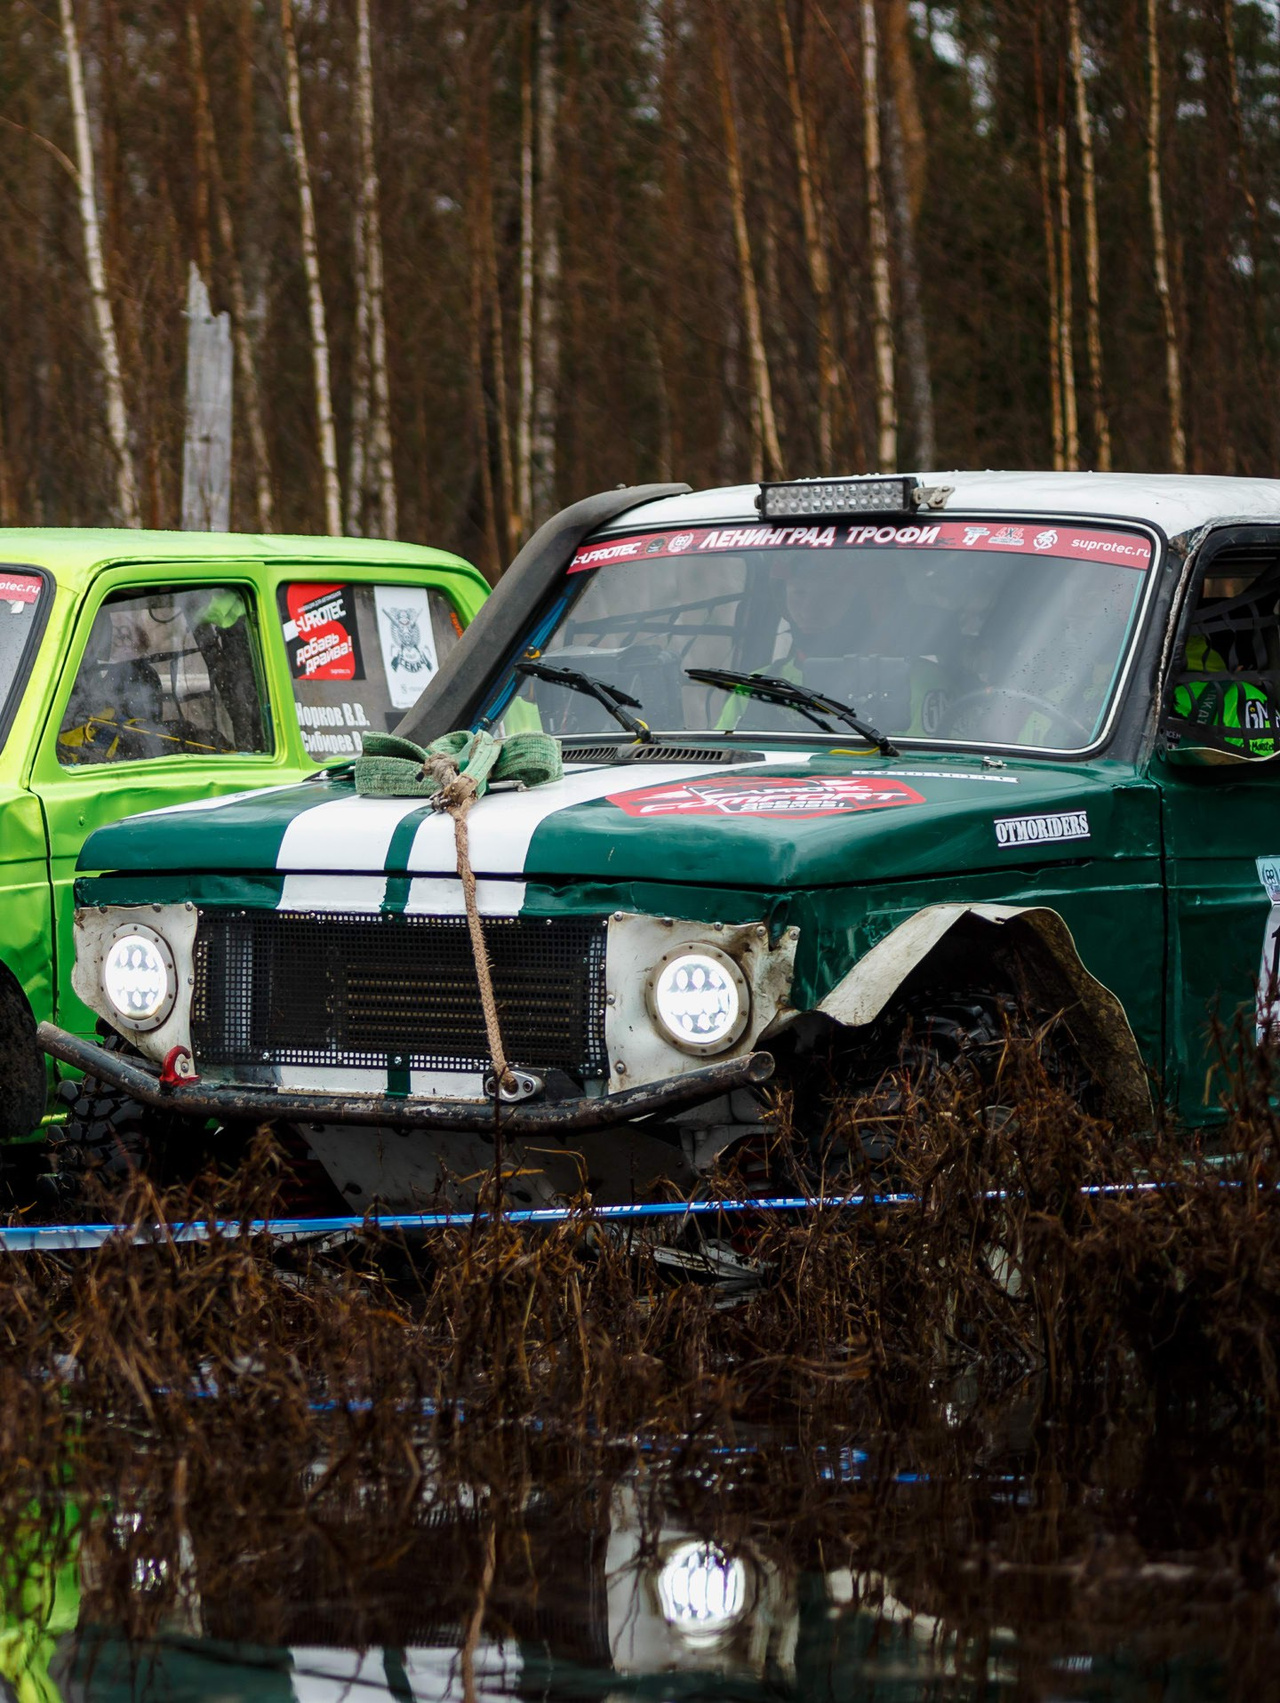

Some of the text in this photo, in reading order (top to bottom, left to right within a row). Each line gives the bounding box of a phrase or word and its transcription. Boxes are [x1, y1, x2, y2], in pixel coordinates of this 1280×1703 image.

[699, 526, 836, 549] ЛЕНИНГРАД
[845, 526, 941, 545] ТРОФИ
[1071, 537, 1151, 558] suprotec.ru
[295, 599, 347, 632] SUPROTEC
[995, 814, 1089, 843] OTMORIDERS
